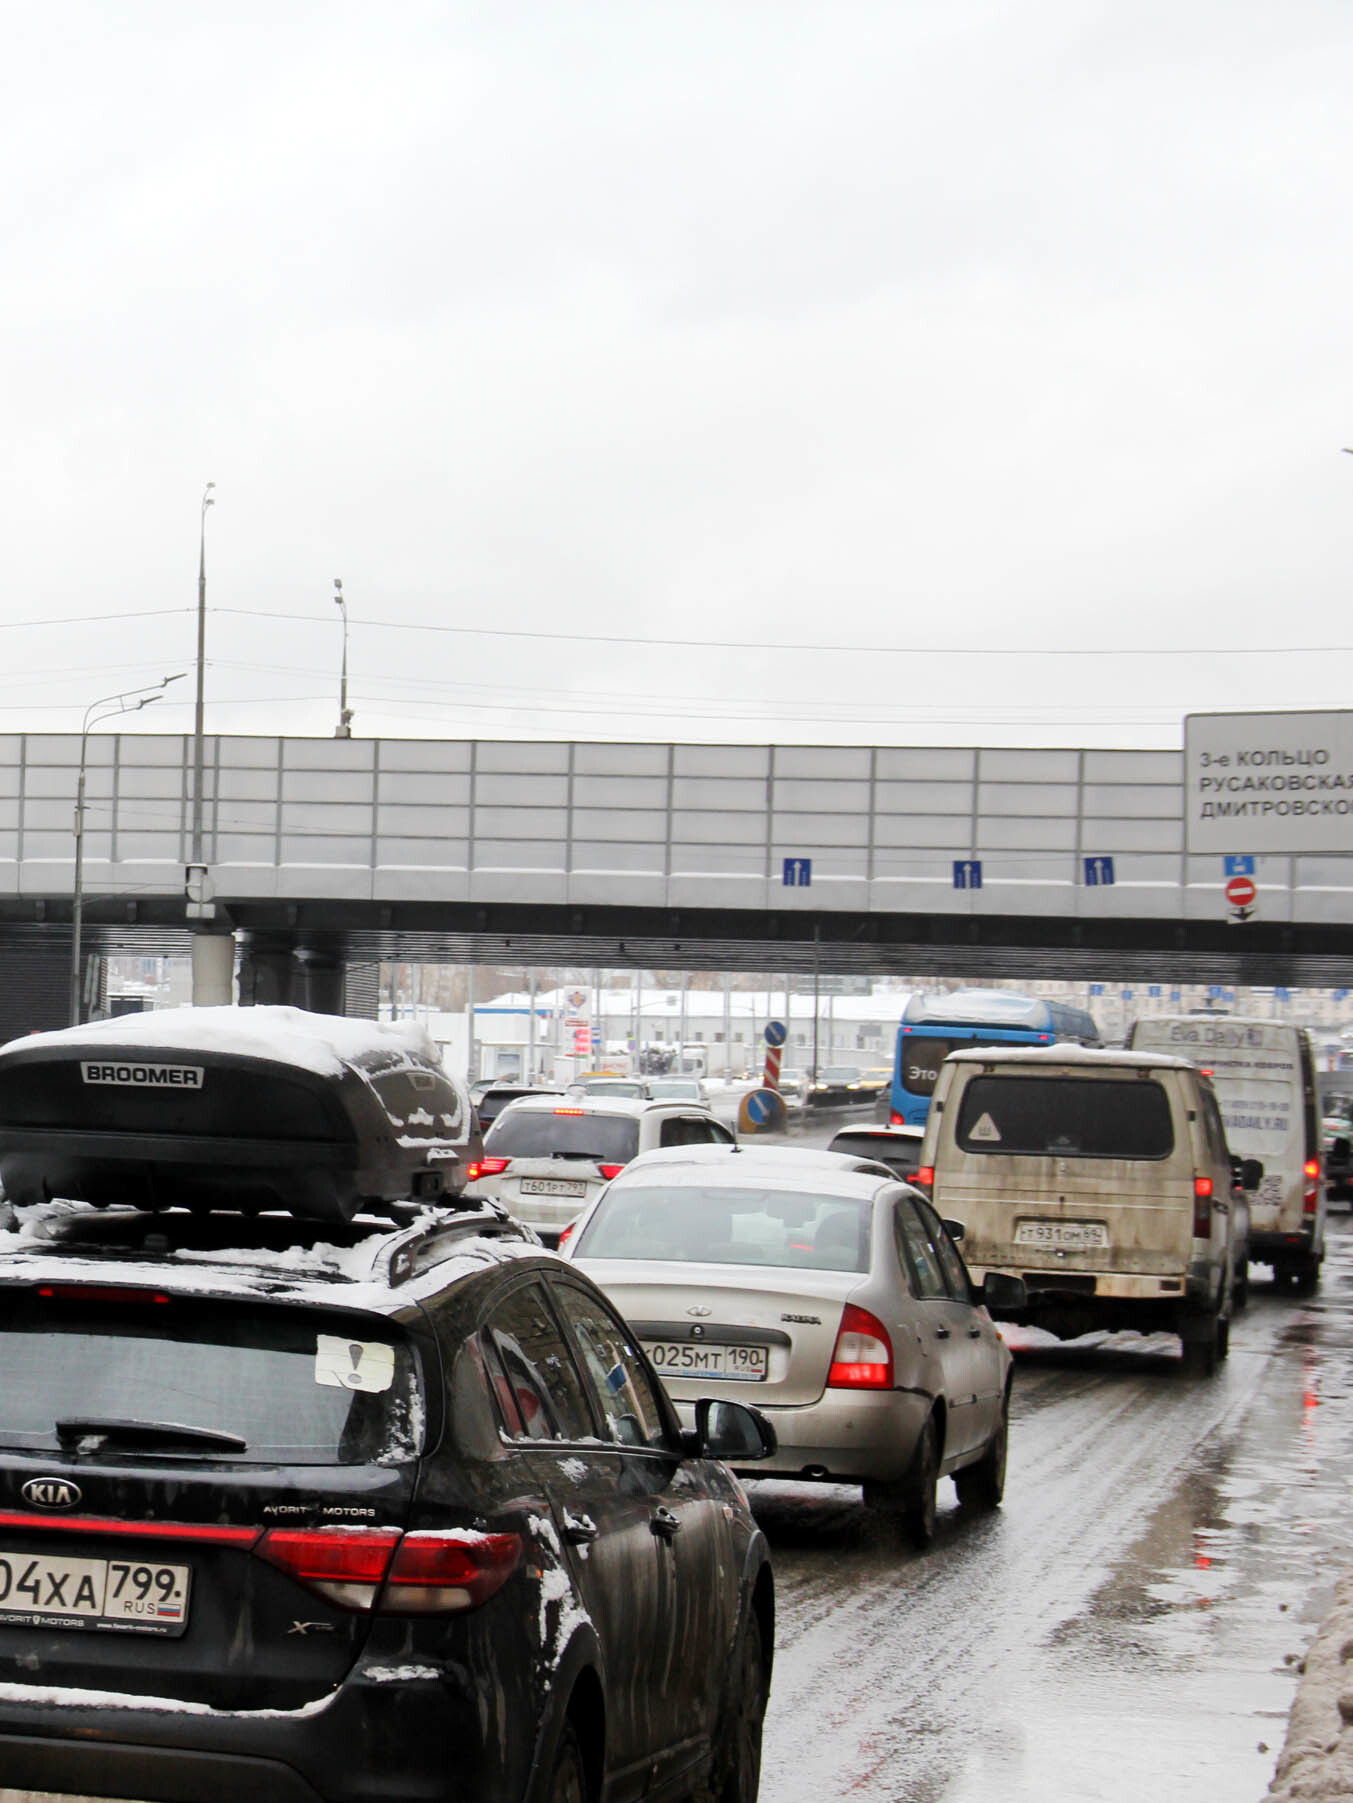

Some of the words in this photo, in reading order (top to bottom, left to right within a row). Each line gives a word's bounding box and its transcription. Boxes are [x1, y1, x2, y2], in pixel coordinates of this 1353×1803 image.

[1237, 749, 1330, 768] КОЛЬЦО
[1200, 799, 1353, 820] ДМИТРОВСКО
[87, 1066, 198, 1085] BROOMER
[909, 1066, 938, 1080] Это
[647, 1345, 722, 1369] 025МТ
[31, 1484, 71, 1503] KIA
[323, 1507, 375, 1517] MOTORS
[111, 1564, 175, 1602] 799
[124, 1601, 156, 1615] RUS
[41, 1617, 85, 1627] MOTORS
